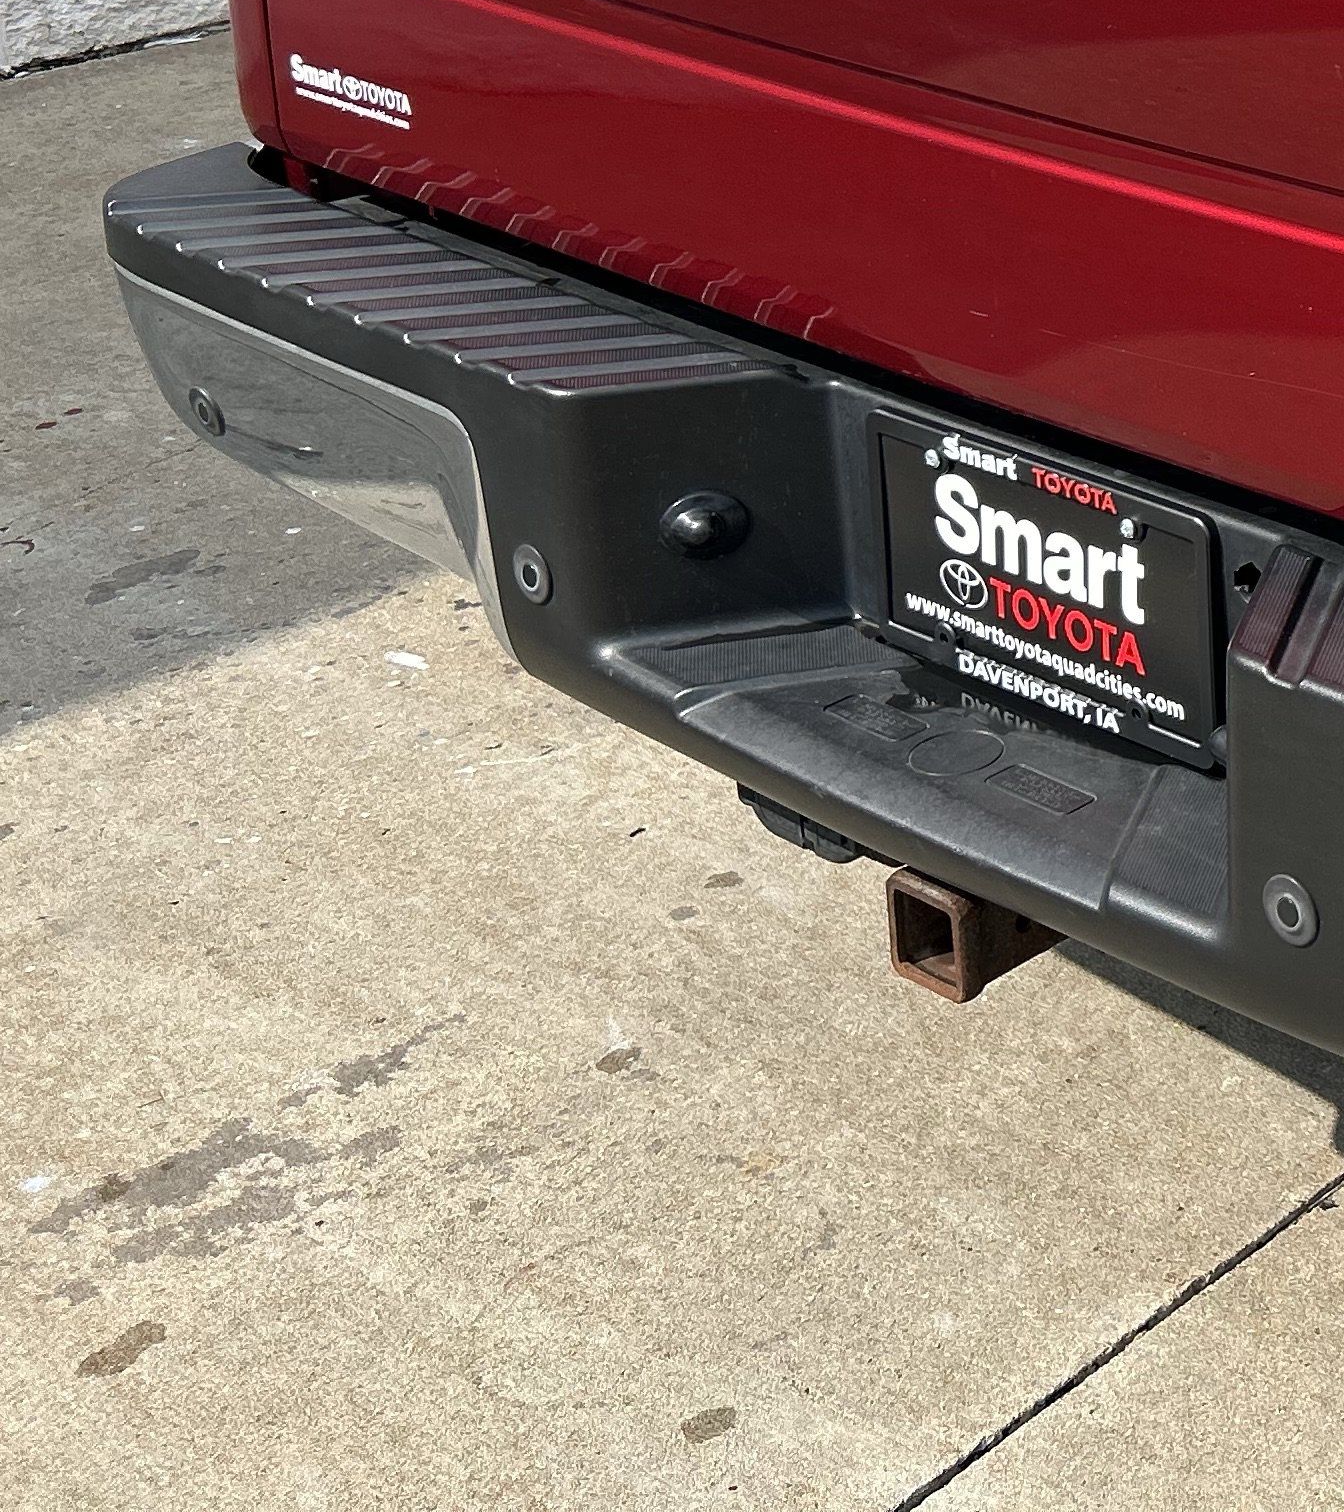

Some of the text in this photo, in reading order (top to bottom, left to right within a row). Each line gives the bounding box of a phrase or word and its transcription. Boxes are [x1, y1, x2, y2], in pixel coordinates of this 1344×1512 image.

[290, 53, 343, 95] Smart
[359, 80, 412, 116] TOYOTA
[942, 433, 1118, 515] Smart TOYOTA
[934, 473, 1145, 625] Smart
[906, 591, 1186, 721] www.smarttoyotaquadcities.com
[989, 576, 1147, 676] TOYOTA
[957, 651, 1092, 724] DAVENPORT,
[1096, 706, 1121, 734] IA
